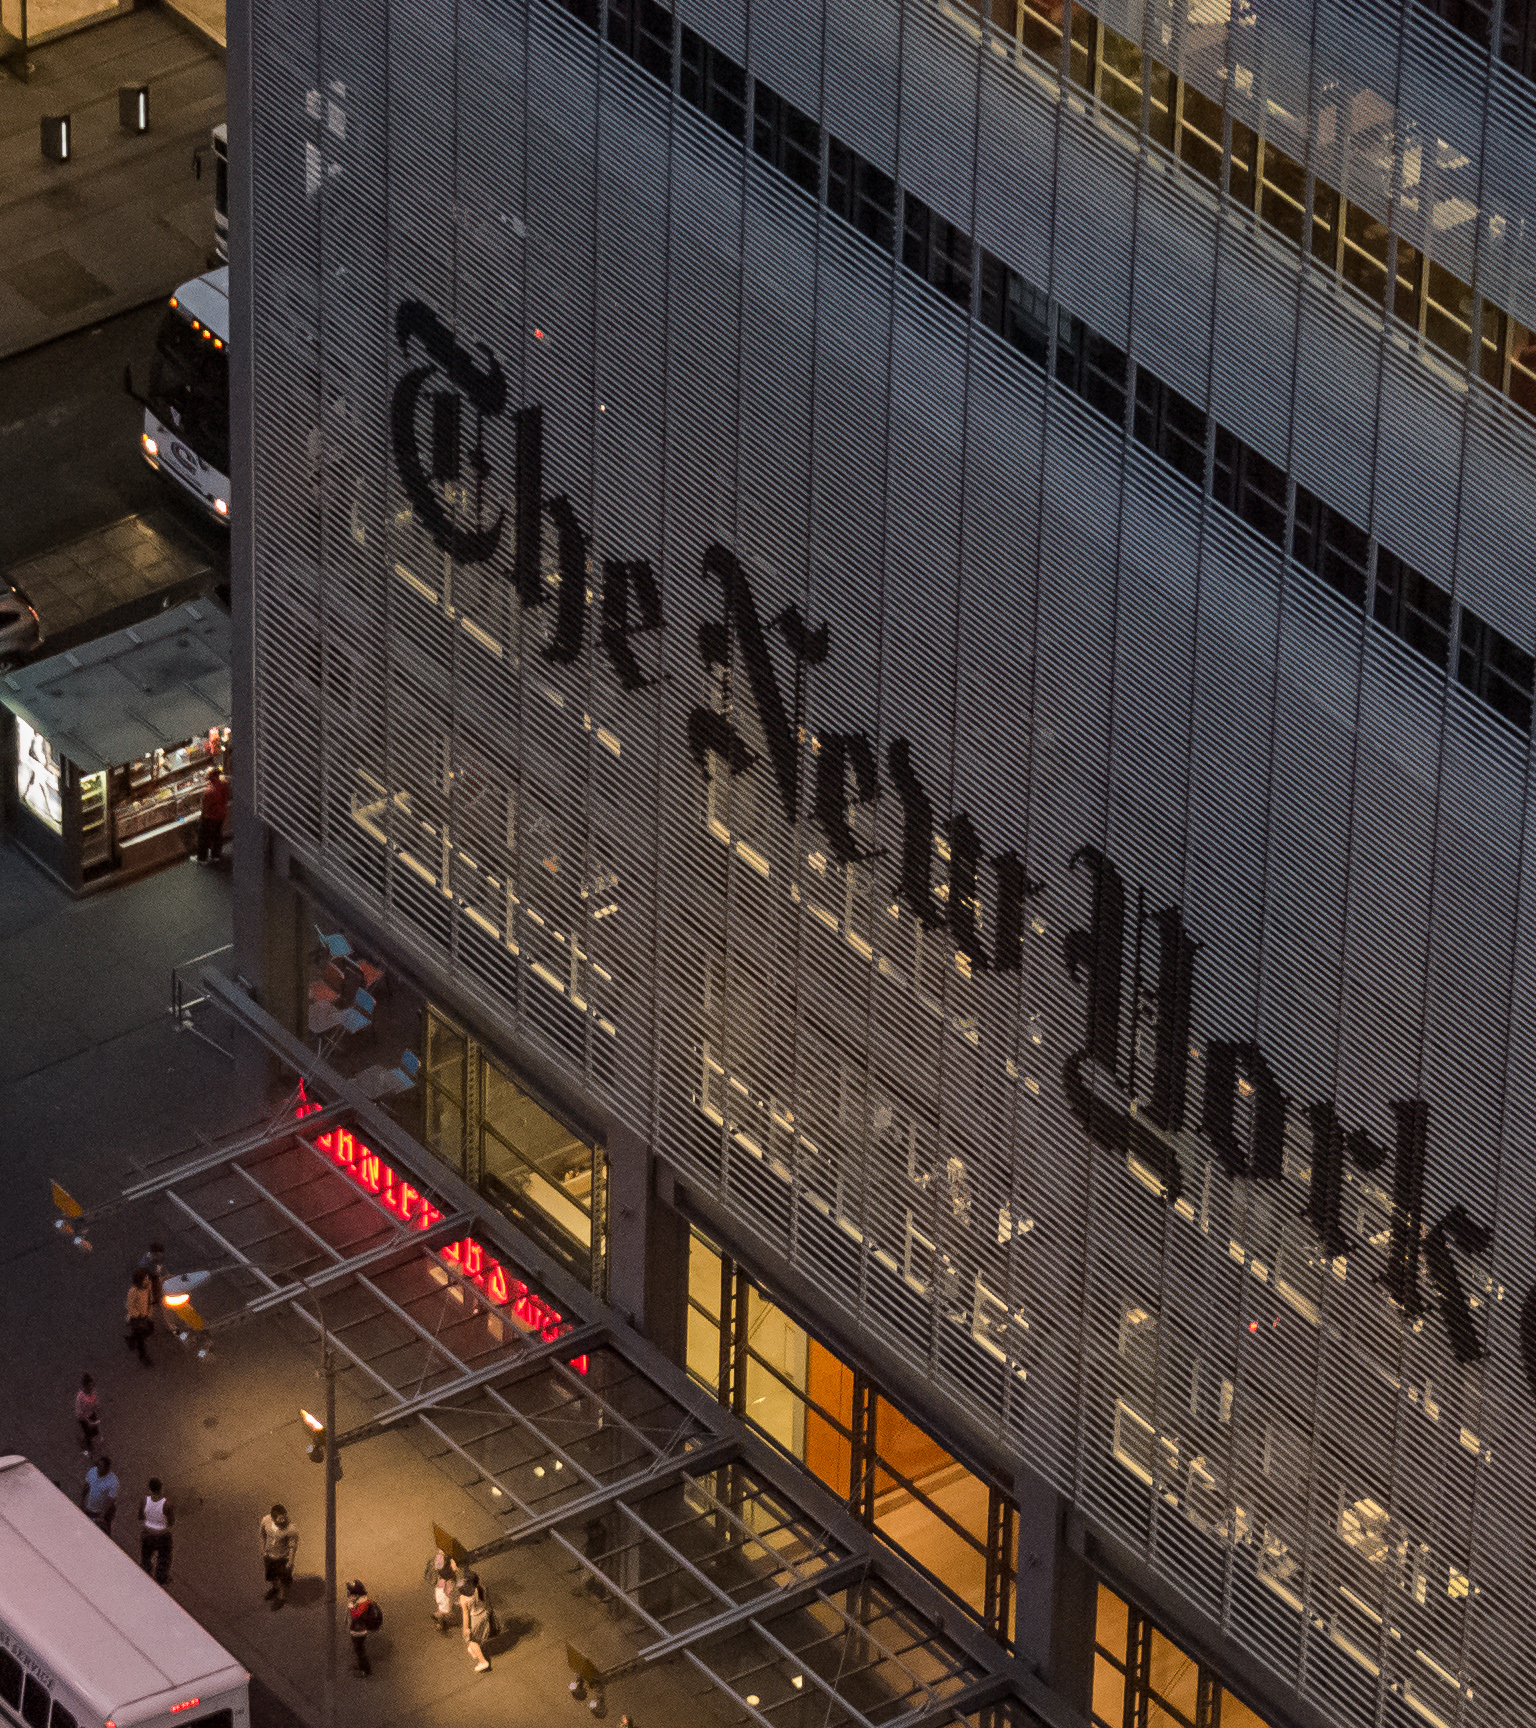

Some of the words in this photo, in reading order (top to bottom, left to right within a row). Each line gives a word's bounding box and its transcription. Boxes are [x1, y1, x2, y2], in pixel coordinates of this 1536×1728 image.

[391, 298, 671, 692] The
[687, 541, 1046, 973] New
[1062, 845, 1496, 1362] York
